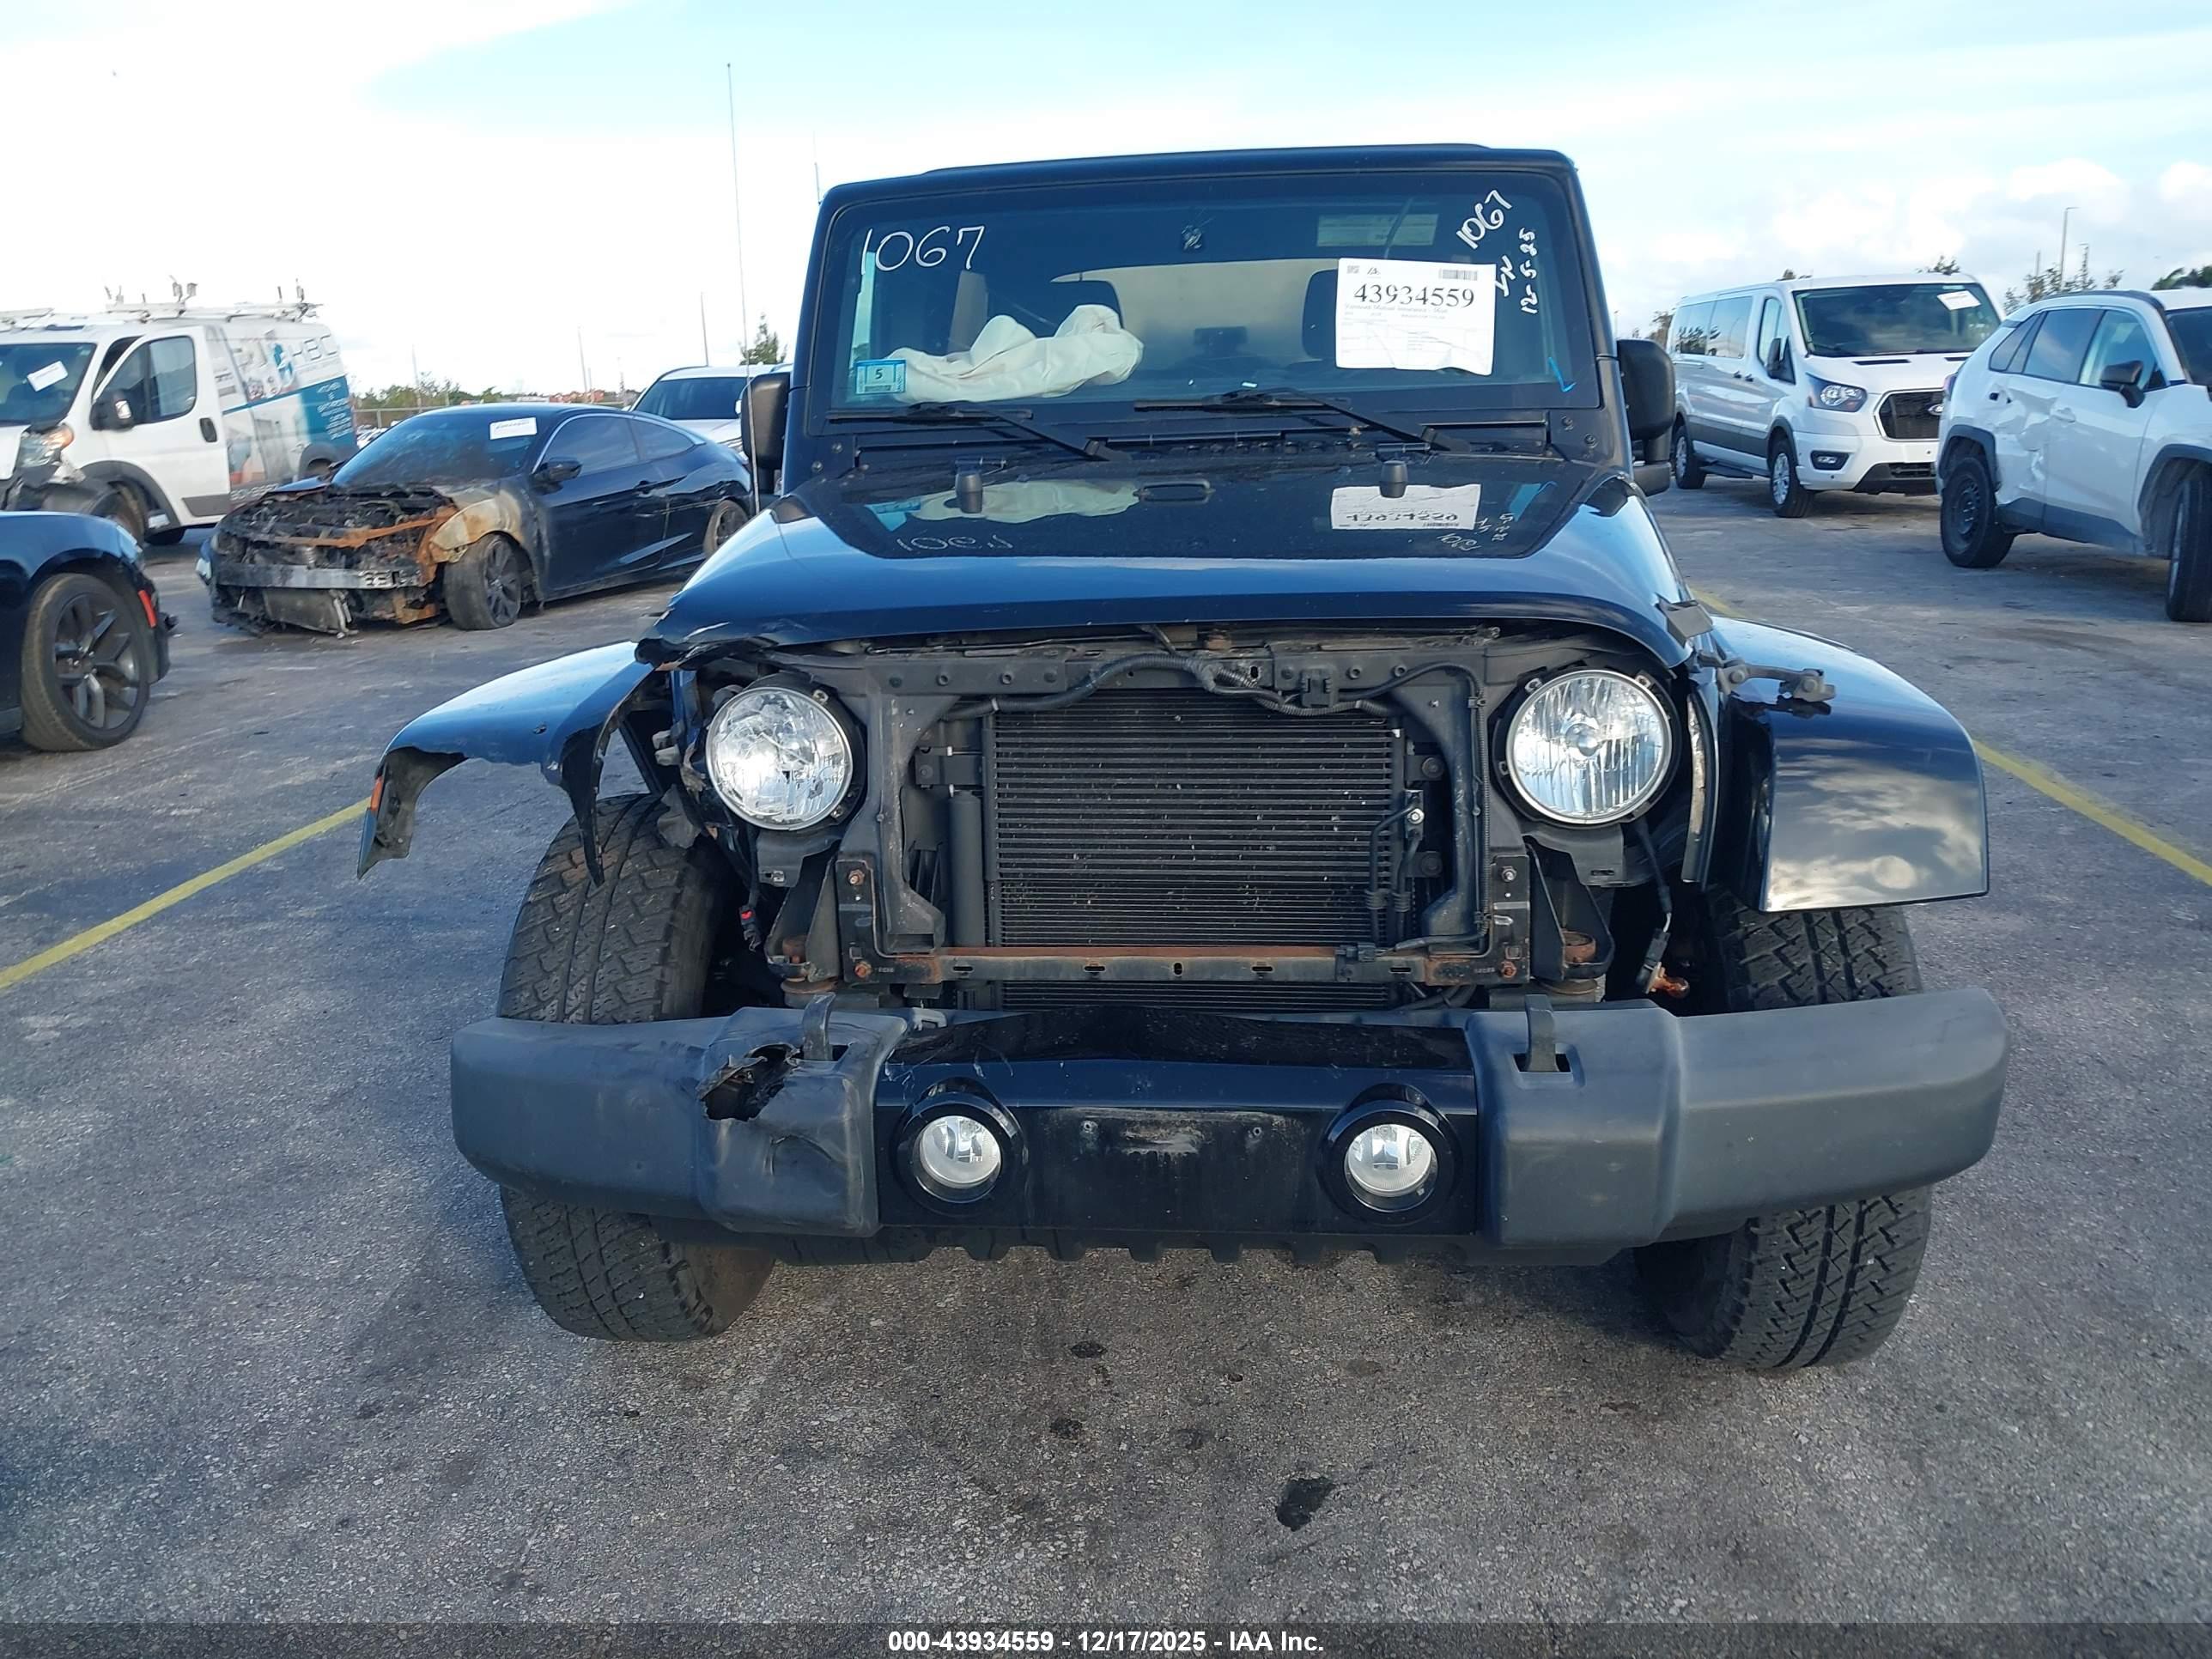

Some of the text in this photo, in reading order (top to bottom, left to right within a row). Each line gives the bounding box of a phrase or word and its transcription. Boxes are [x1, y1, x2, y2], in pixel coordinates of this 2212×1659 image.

[1456, 190, 1512, 250] 1067
[860, 225, 986, 276] 1067
[1353, 283, 1475, 309] 43934559
[875, 368, 883, 380] 5
